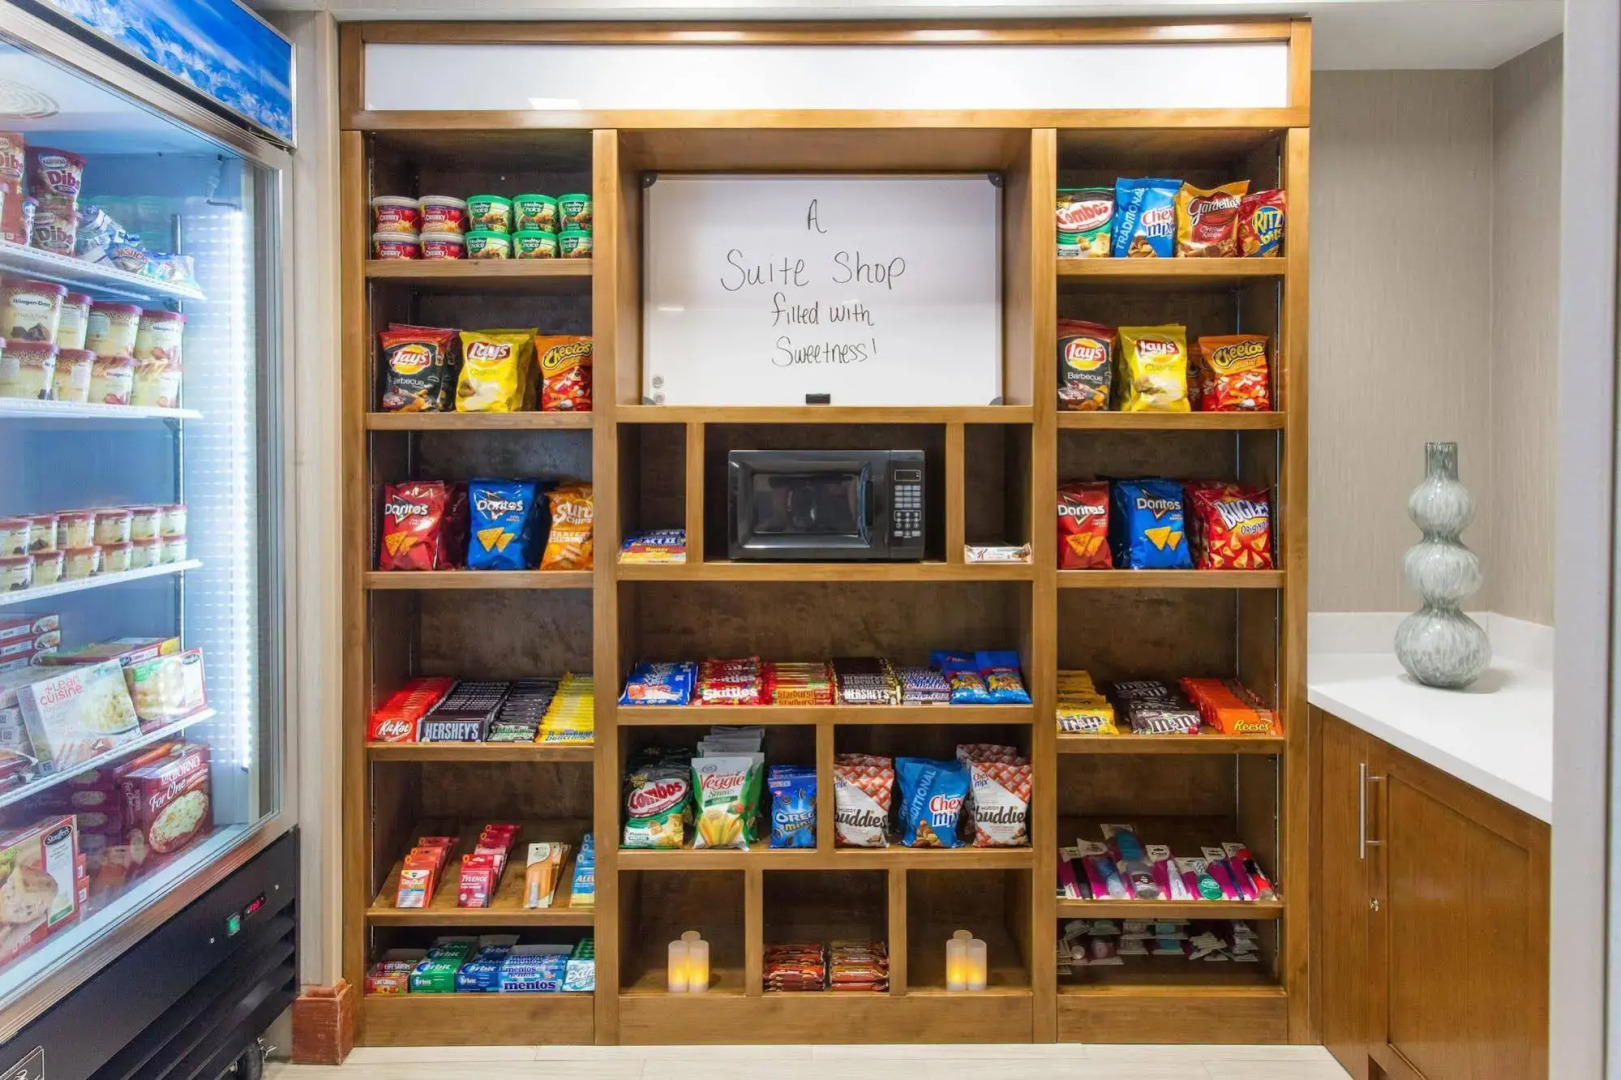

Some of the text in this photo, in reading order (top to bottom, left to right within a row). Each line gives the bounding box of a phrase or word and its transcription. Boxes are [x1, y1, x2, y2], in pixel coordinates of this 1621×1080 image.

[47, 170, 80, 189] Dibs
[807, 199, 827, 234] A
[1115, 187, 1147, 250] TRADITIONAL
[1141, 208, 1176, 226] Chex
[1255, 210, 1282, 233] RITZ
[36, 226, 74, 243] Dibs
[1147, 223, 1175, 238] mix
[721, 249, 905, 291] Suite Shop
[772, 292, 874, 327] filled with
[470, 343, 510, 360] Lay's
[543, 343, 592, 368] Cheetos
[771, 336, 877, 367] Sweetness!
[1067, 344, 1103, 361] Lay's
[1140, 341, 1176, 356] Lay's
[1214, 342, 1265, 367] Cheetos
[393, 350, 428, 366] Lay's
[1068, 371, 1103, 382] Barbecue
[384, 502, 429, 516] Doritos
[477, 500, 524, 512] Doritos
[1058, 504, 1106, 516] Doritos
[1136, 497, 1182, 511] Doritos
[702, 688, 760, 701] Skittles
[844, 689, 890, 700] HERSHEY'S
[425, 722, 479, 740] HERSHEY'S
[700, 772, 746, 791] Veggie
[631, 782, 682, 809] Combos
[930, 794, 964, 813] Chex
[775, 811, 815, 823] OREO
[975, 804, 1026, 824] buddie
[576, 875, 595, 883] ALE
[504, 980, 556, 991] mentos
